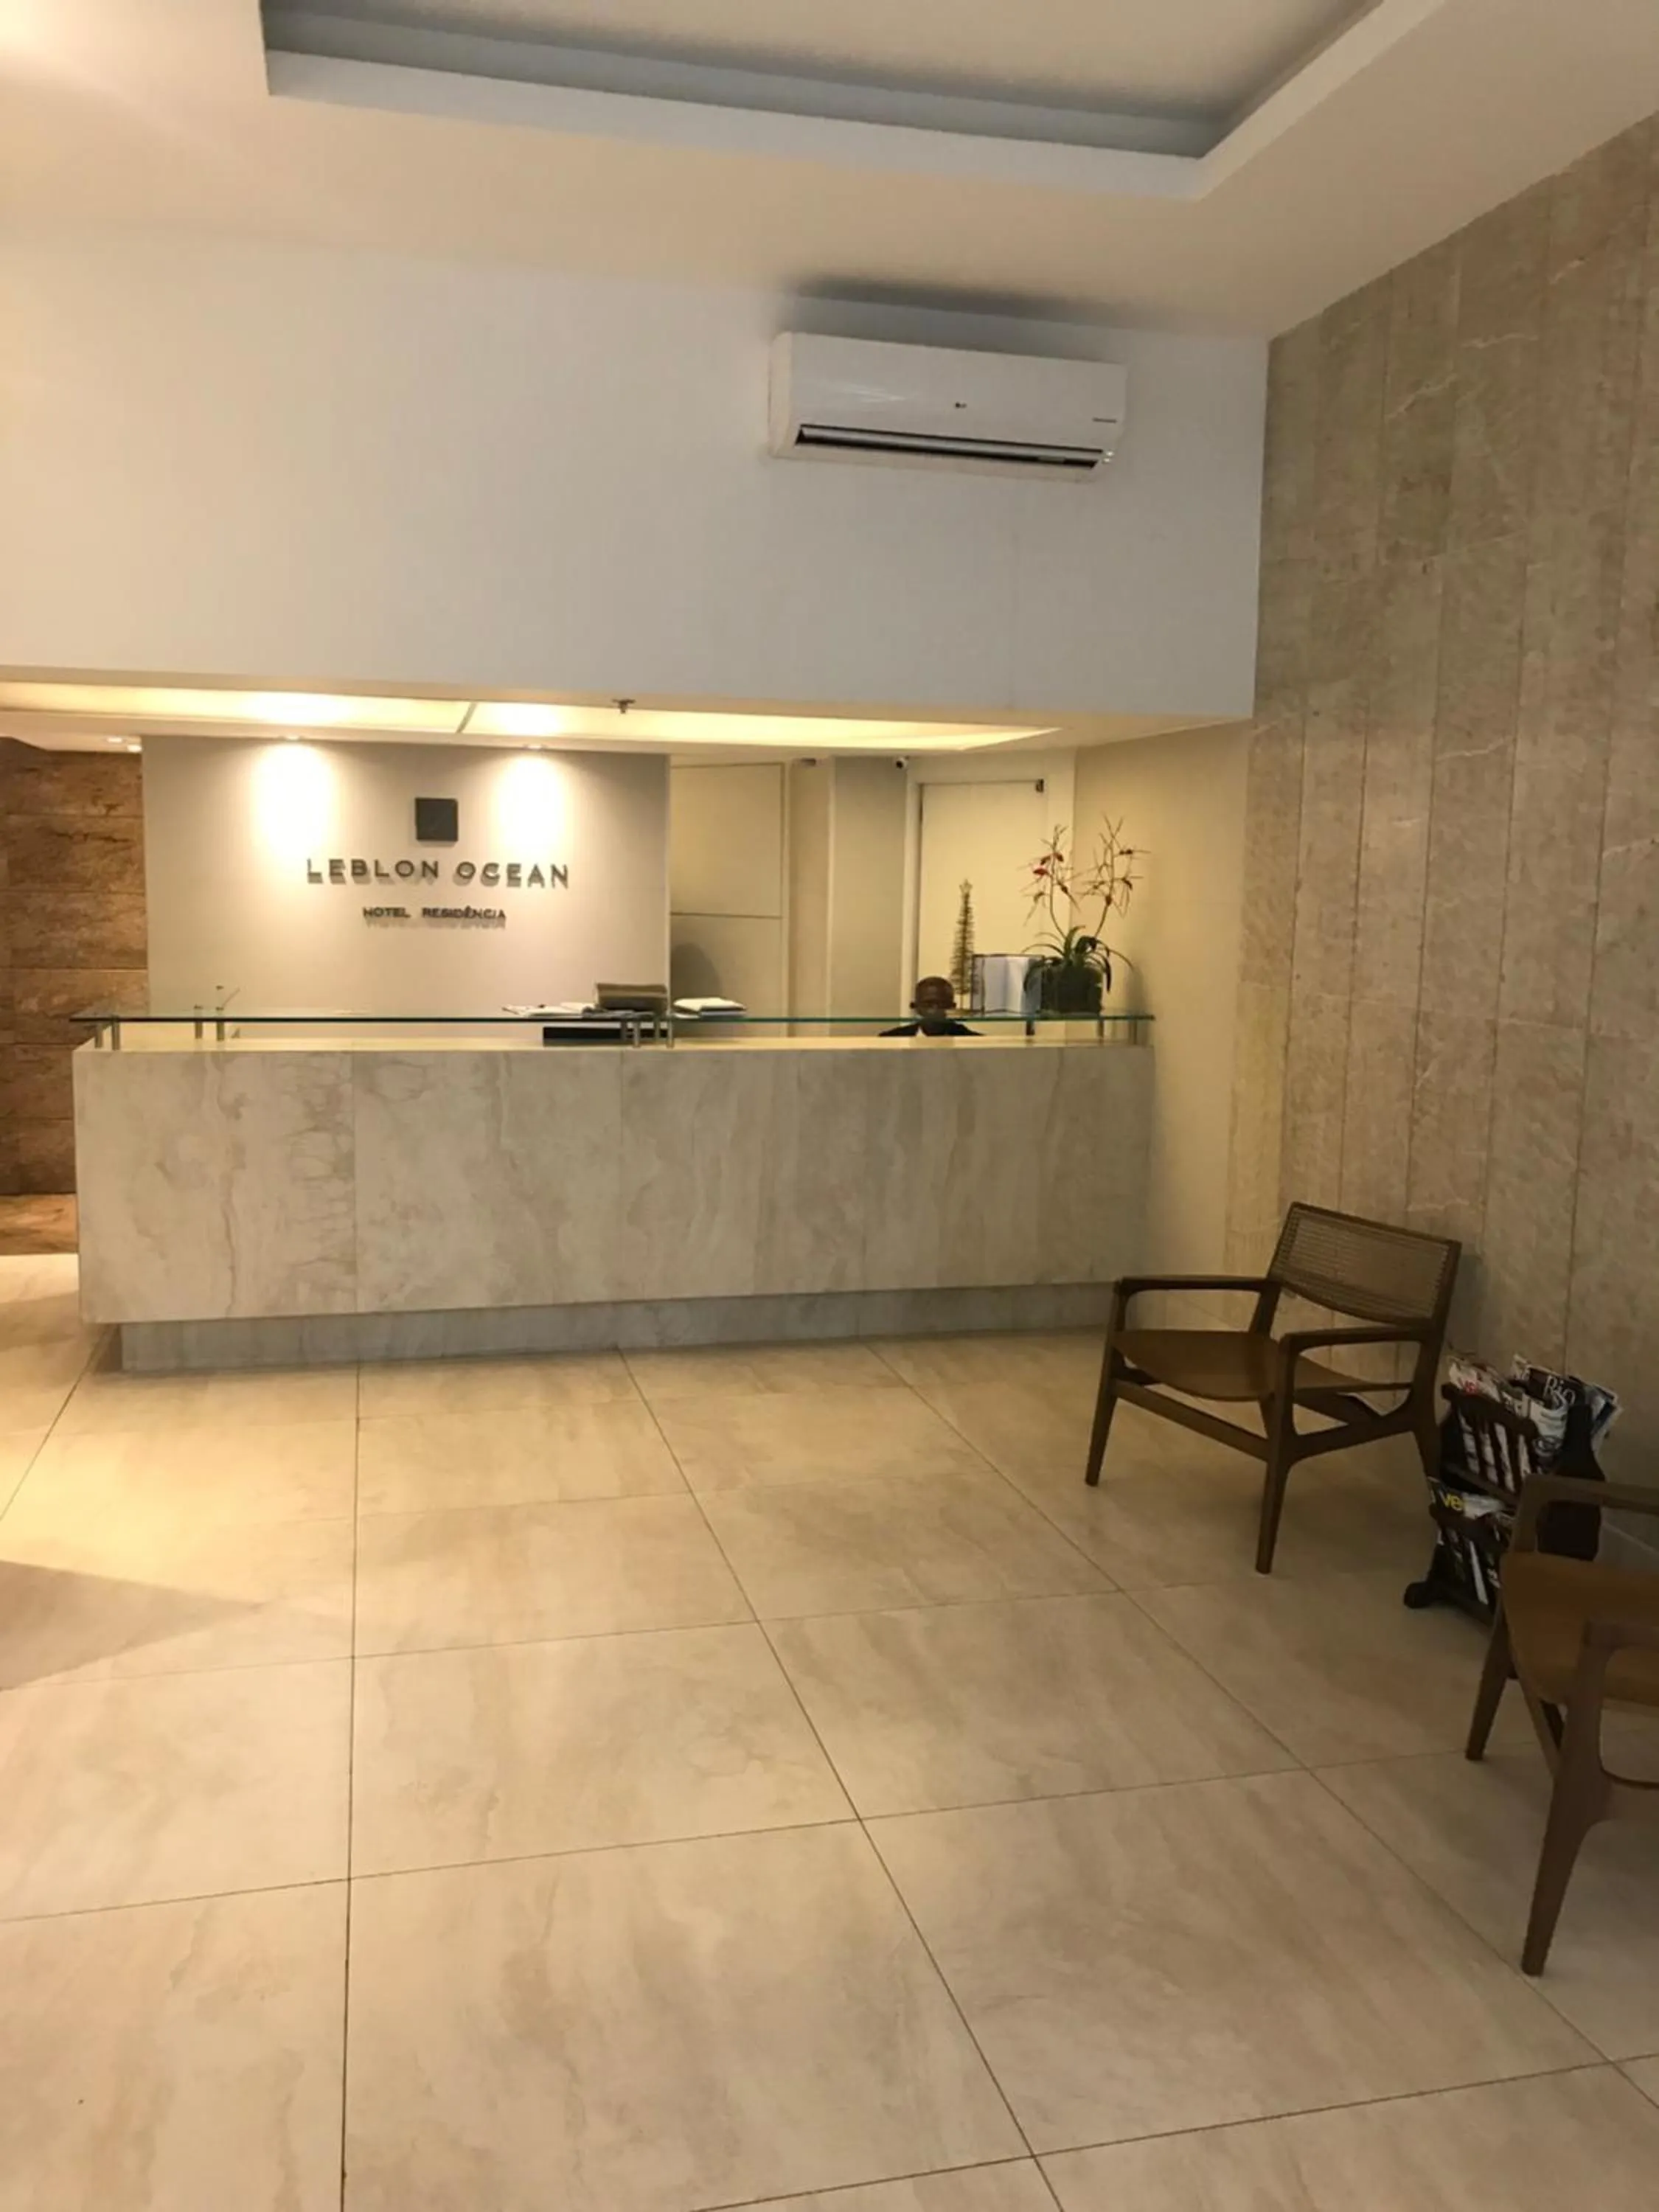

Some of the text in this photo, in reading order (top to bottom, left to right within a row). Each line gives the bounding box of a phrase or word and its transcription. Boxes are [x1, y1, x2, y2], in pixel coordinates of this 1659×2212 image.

[307, 858, 570, 886] LEBLON OCEAN
[363, 905, 507, 919] HOTEL RESIDÊNCIA
